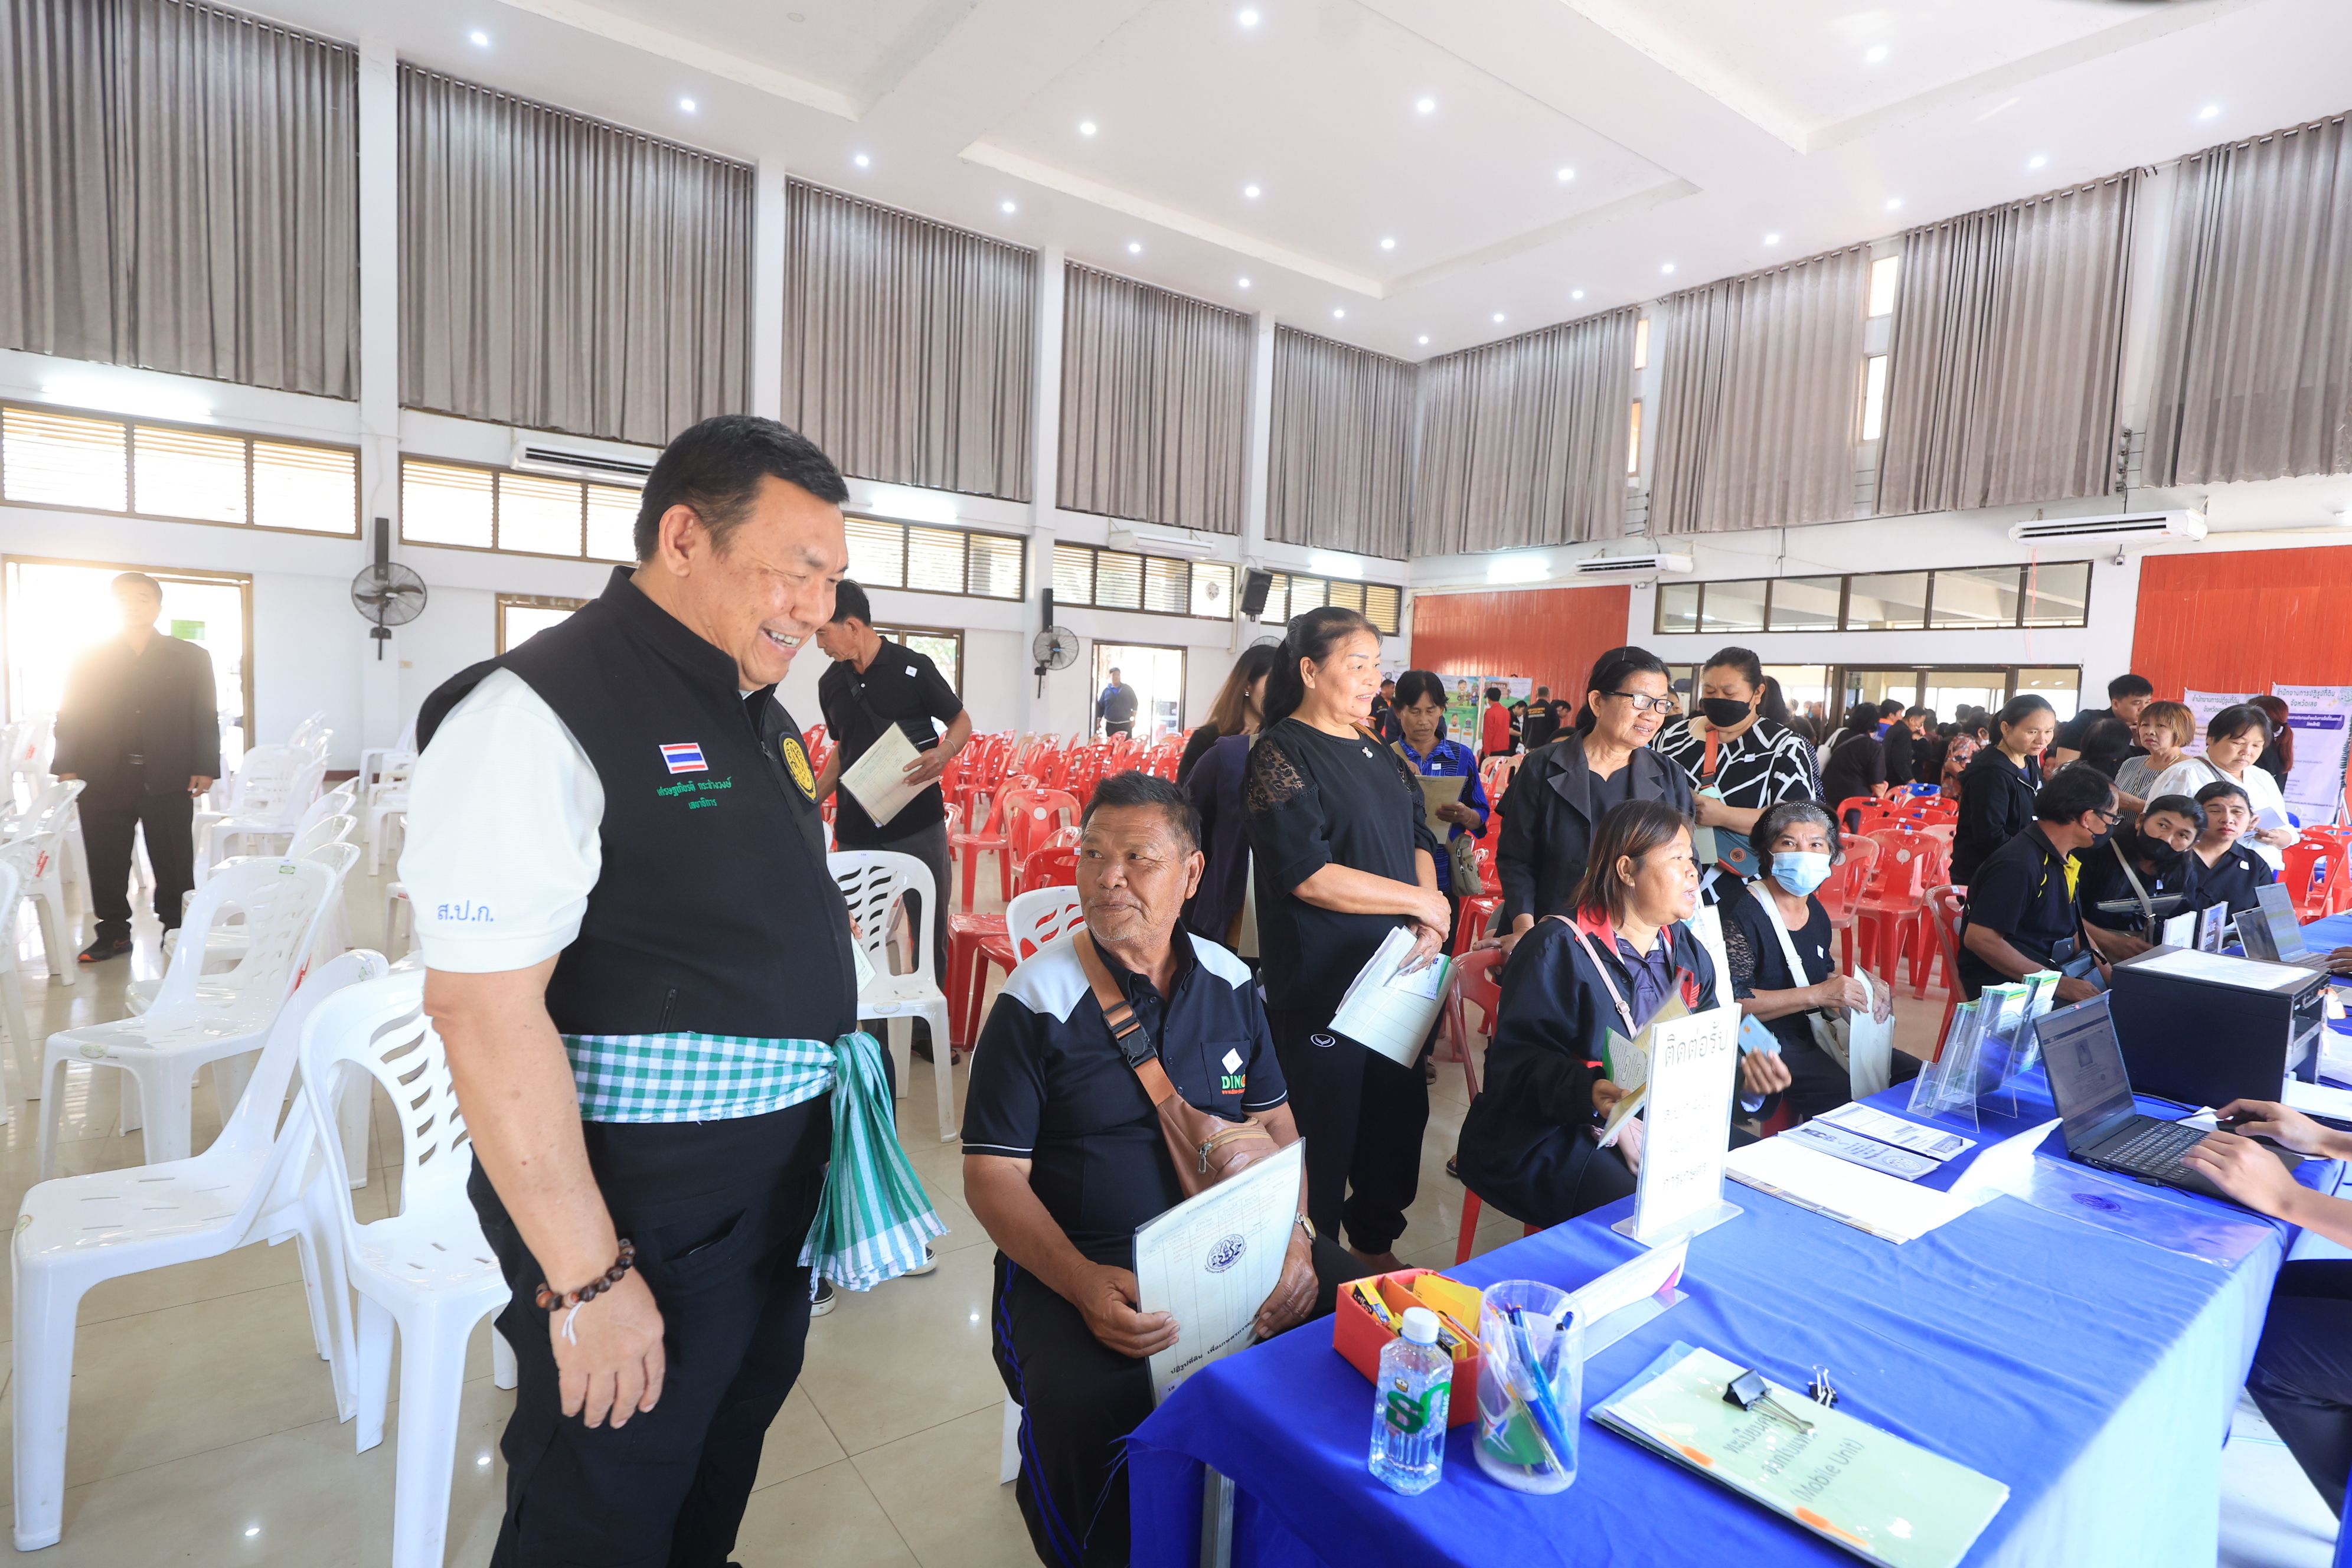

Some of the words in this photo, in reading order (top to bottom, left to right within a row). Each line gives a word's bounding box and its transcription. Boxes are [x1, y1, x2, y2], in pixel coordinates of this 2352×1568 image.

[437, 900, 494, 922] ส.ป.ก.
[1665, 1020, 1729, 1067] ติดต่อรับ
[1828, 1438, 1866, 1465] Unit)
